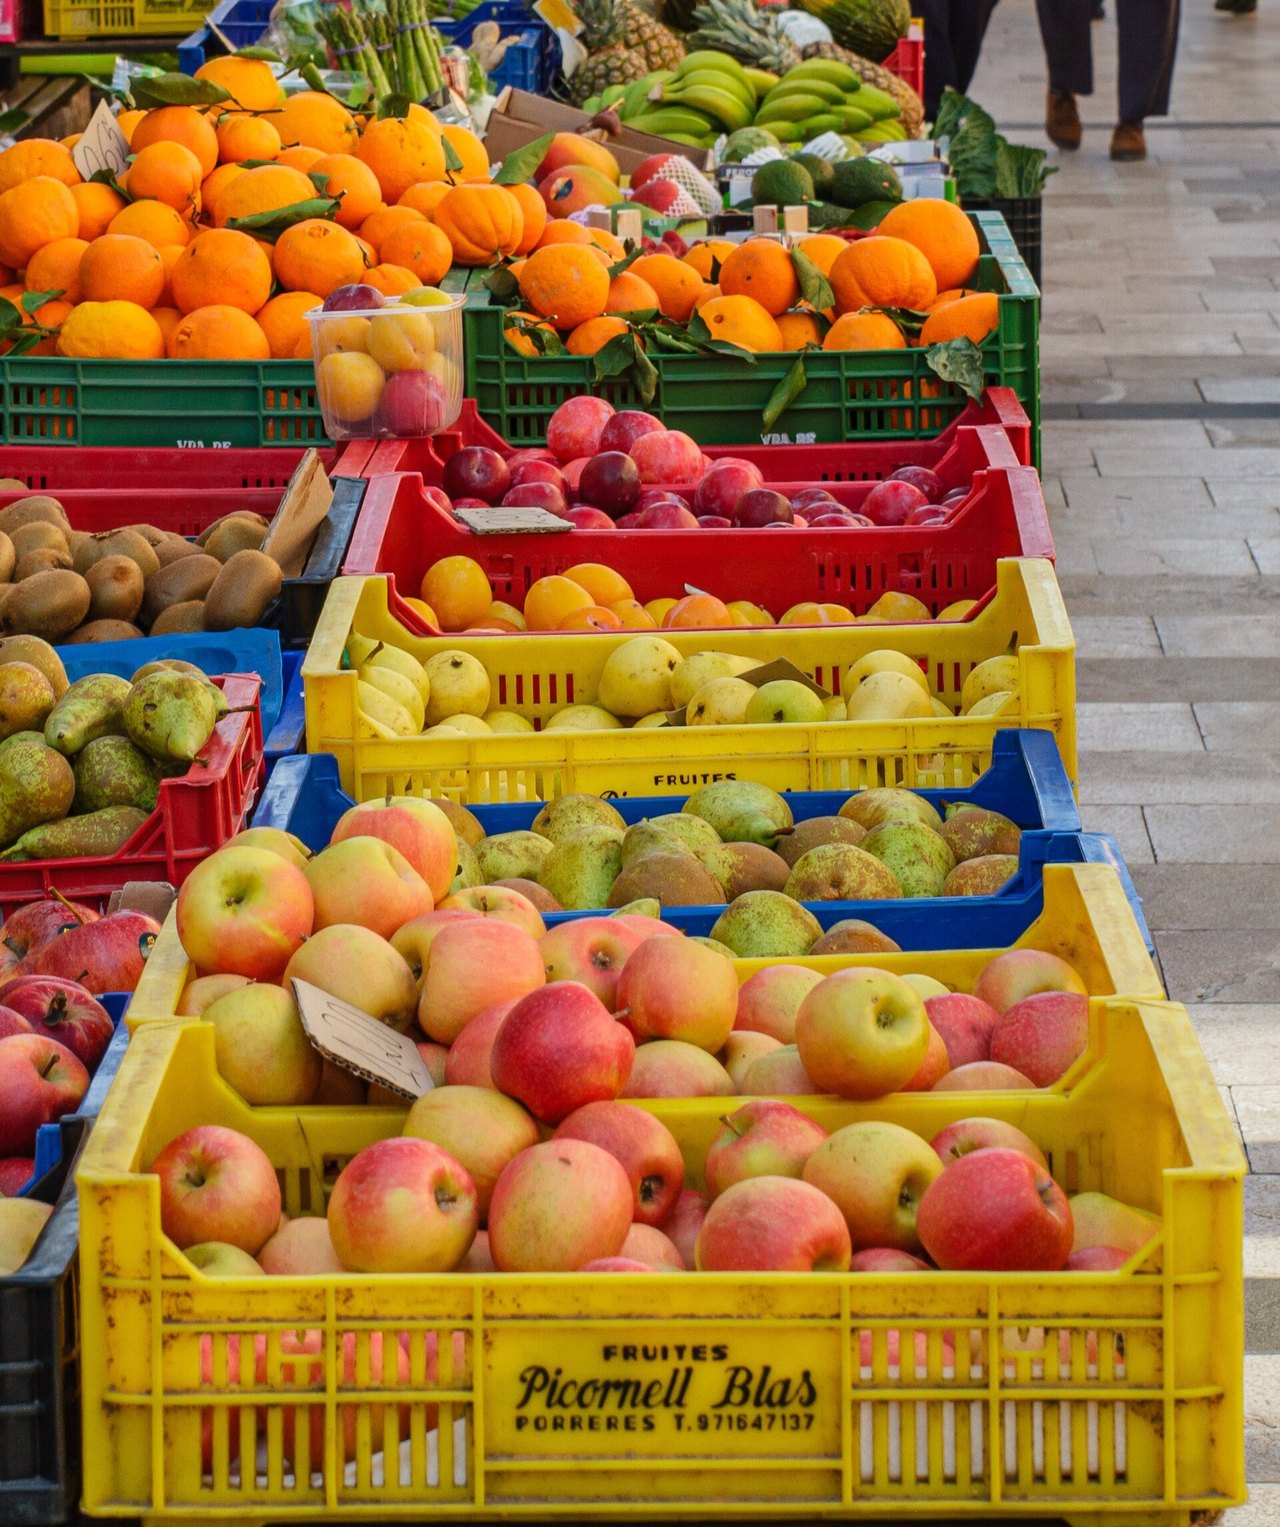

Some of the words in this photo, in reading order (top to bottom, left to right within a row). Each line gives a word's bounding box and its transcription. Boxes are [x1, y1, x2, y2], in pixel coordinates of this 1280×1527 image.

[653, 773, 737, 787] FRUITES
[602, 1344, 729, 1362] FRUITES
[515, 1365, 693, 1410] Picornell
[710, 1365, 818, 1409] Blas
[515, 1414, 656, 1432] PORRERES
